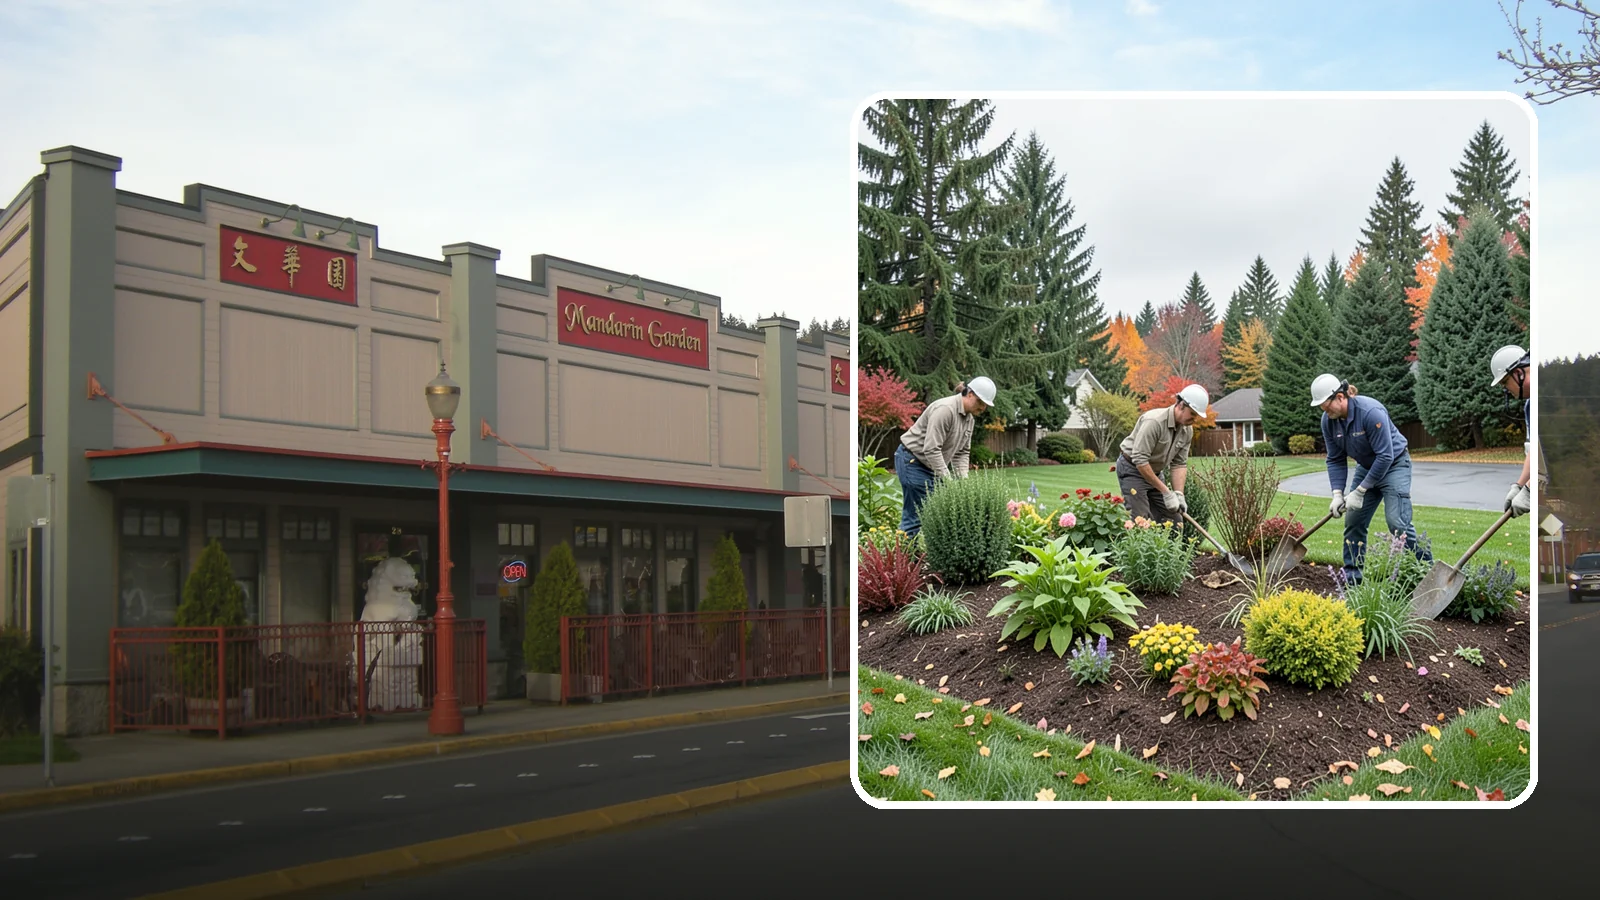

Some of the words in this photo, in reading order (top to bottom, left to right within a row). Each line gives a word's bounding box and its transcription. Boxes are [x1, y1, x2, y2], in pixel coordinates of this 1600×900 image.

[231, 235, 346, 291] 文華園
[564, 302, 644, 341] Mandarin
[648, 320, 702, 352] Garden
[503, 565, 527, 578] OPEN
